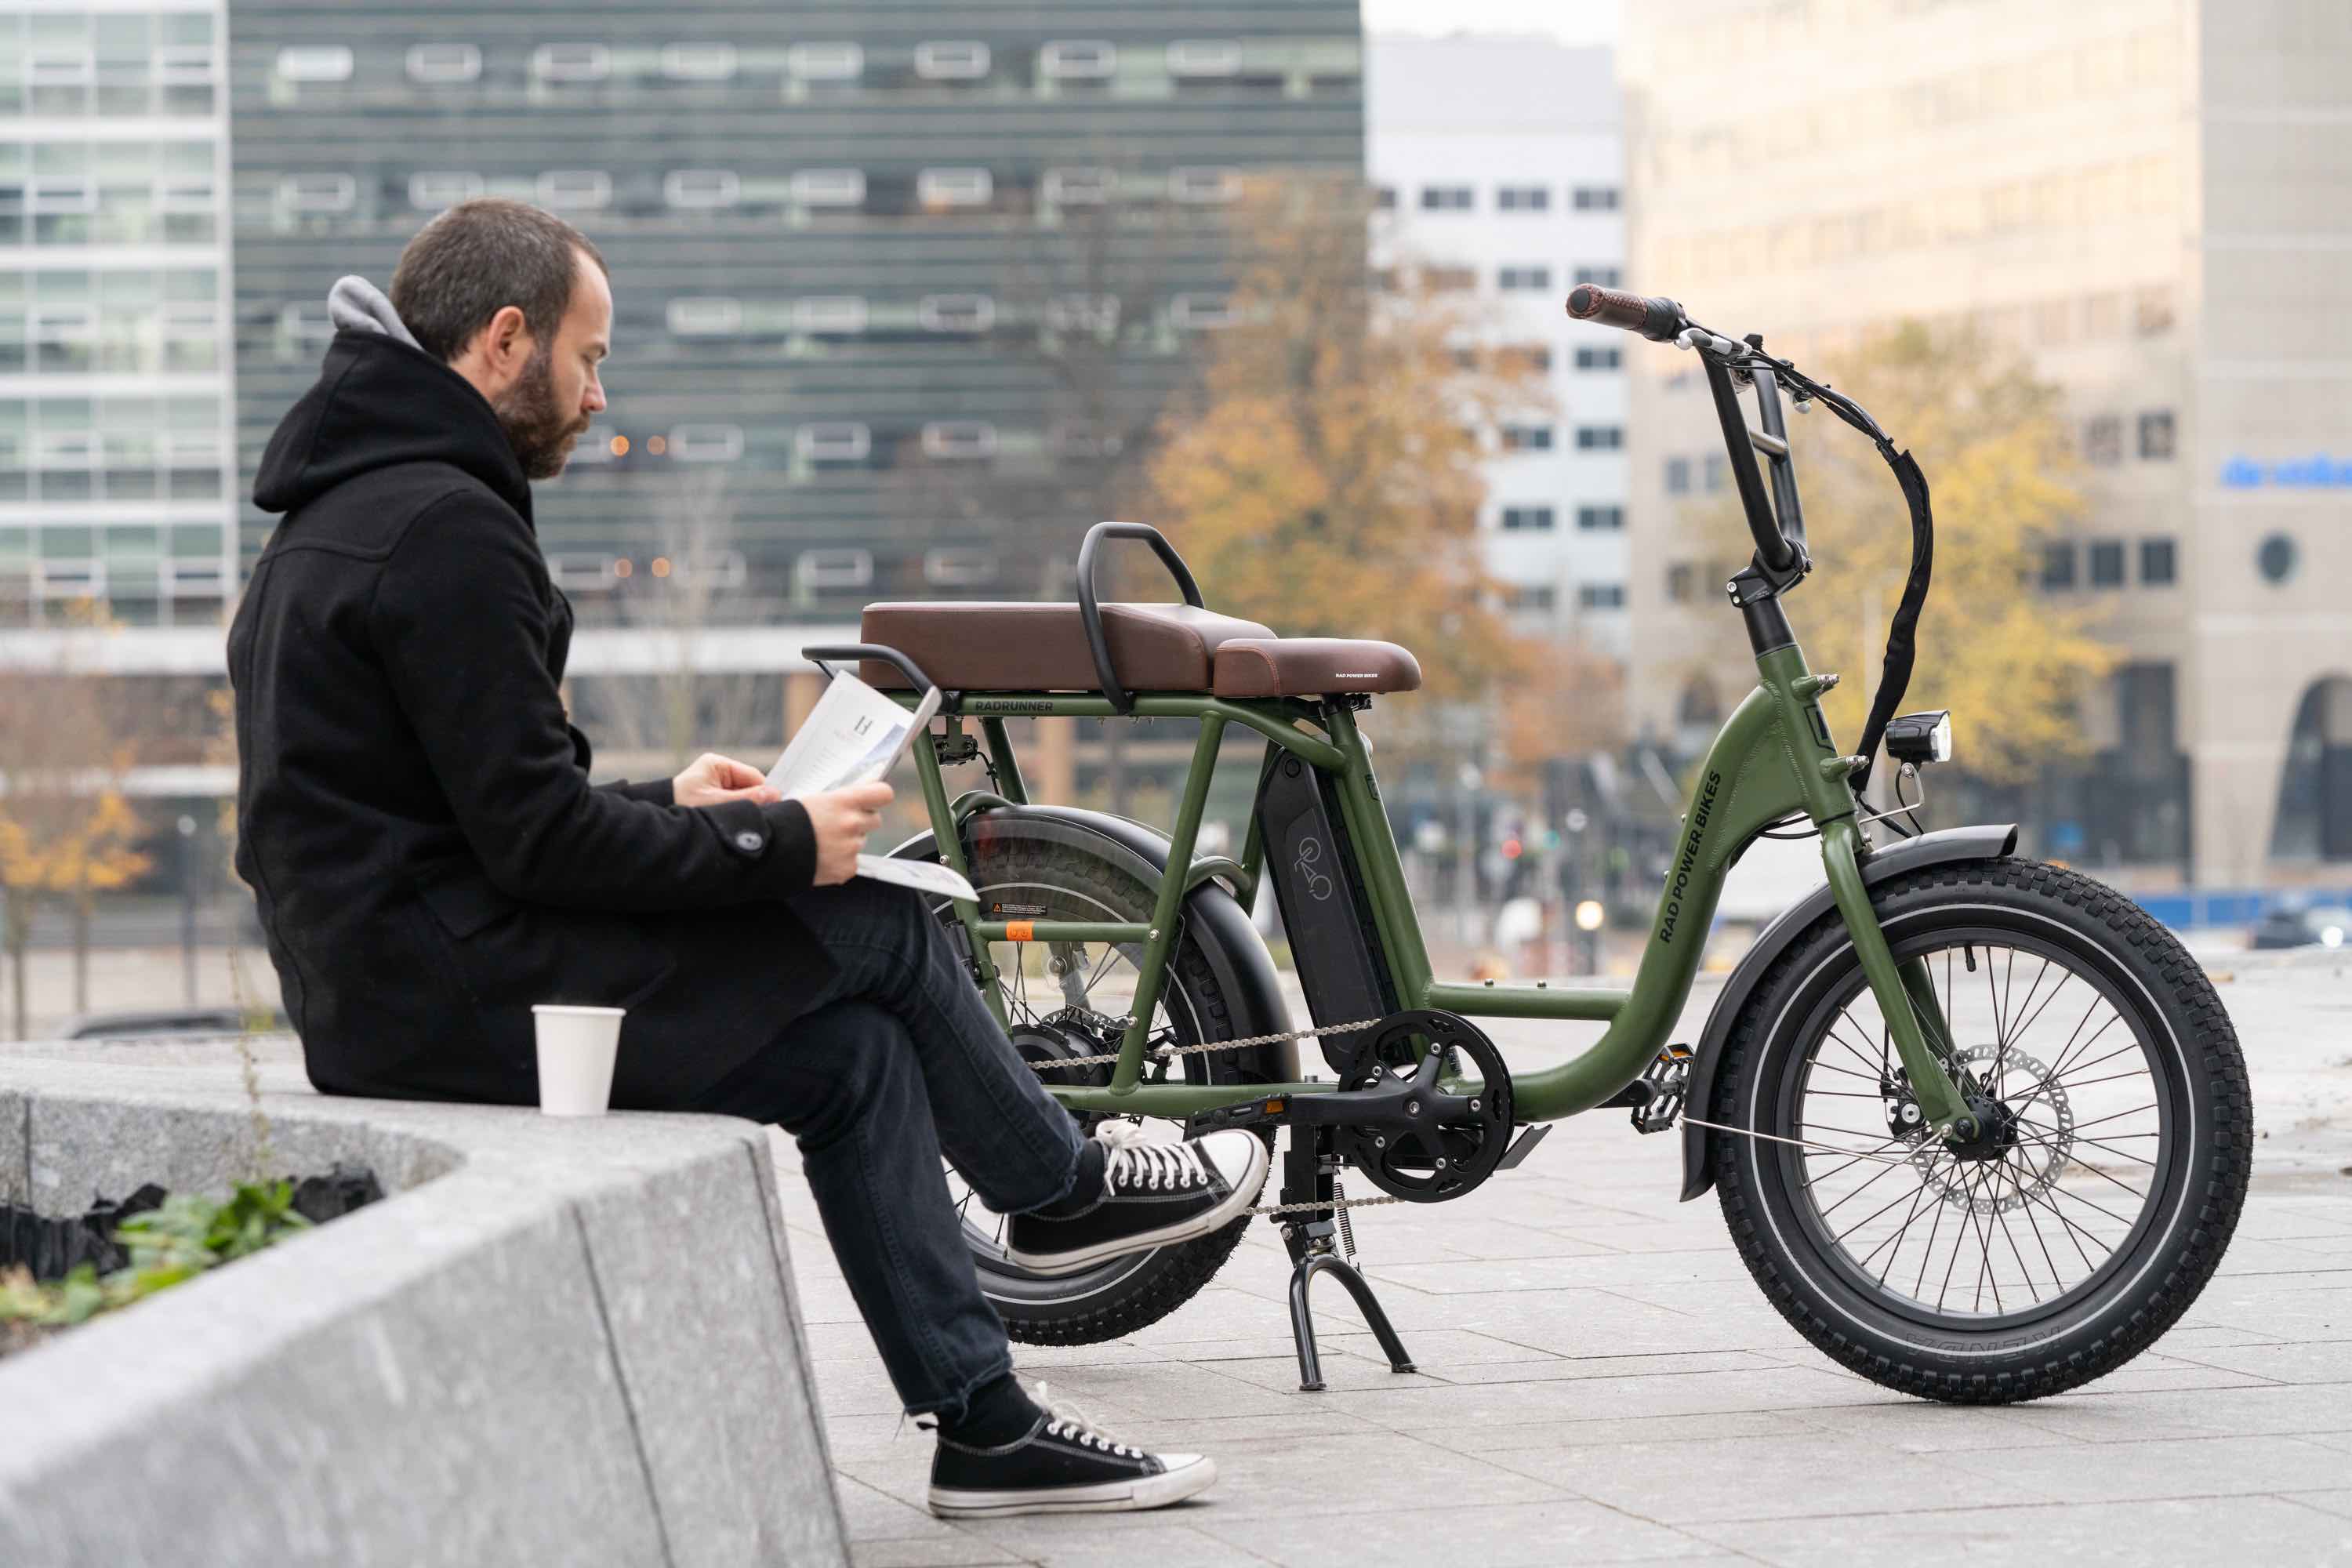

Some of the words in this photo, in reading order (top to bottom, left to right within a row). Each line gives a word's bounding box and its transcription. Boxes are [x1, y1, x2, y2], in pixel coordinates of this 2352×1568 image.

[975, 700, 1054, 712] RADRUNNER
[1660, 902, 1679, 943] RAD
[1672, 829, 1702, 900] POWER
[1695, 771, 1721, 828] BIKES
